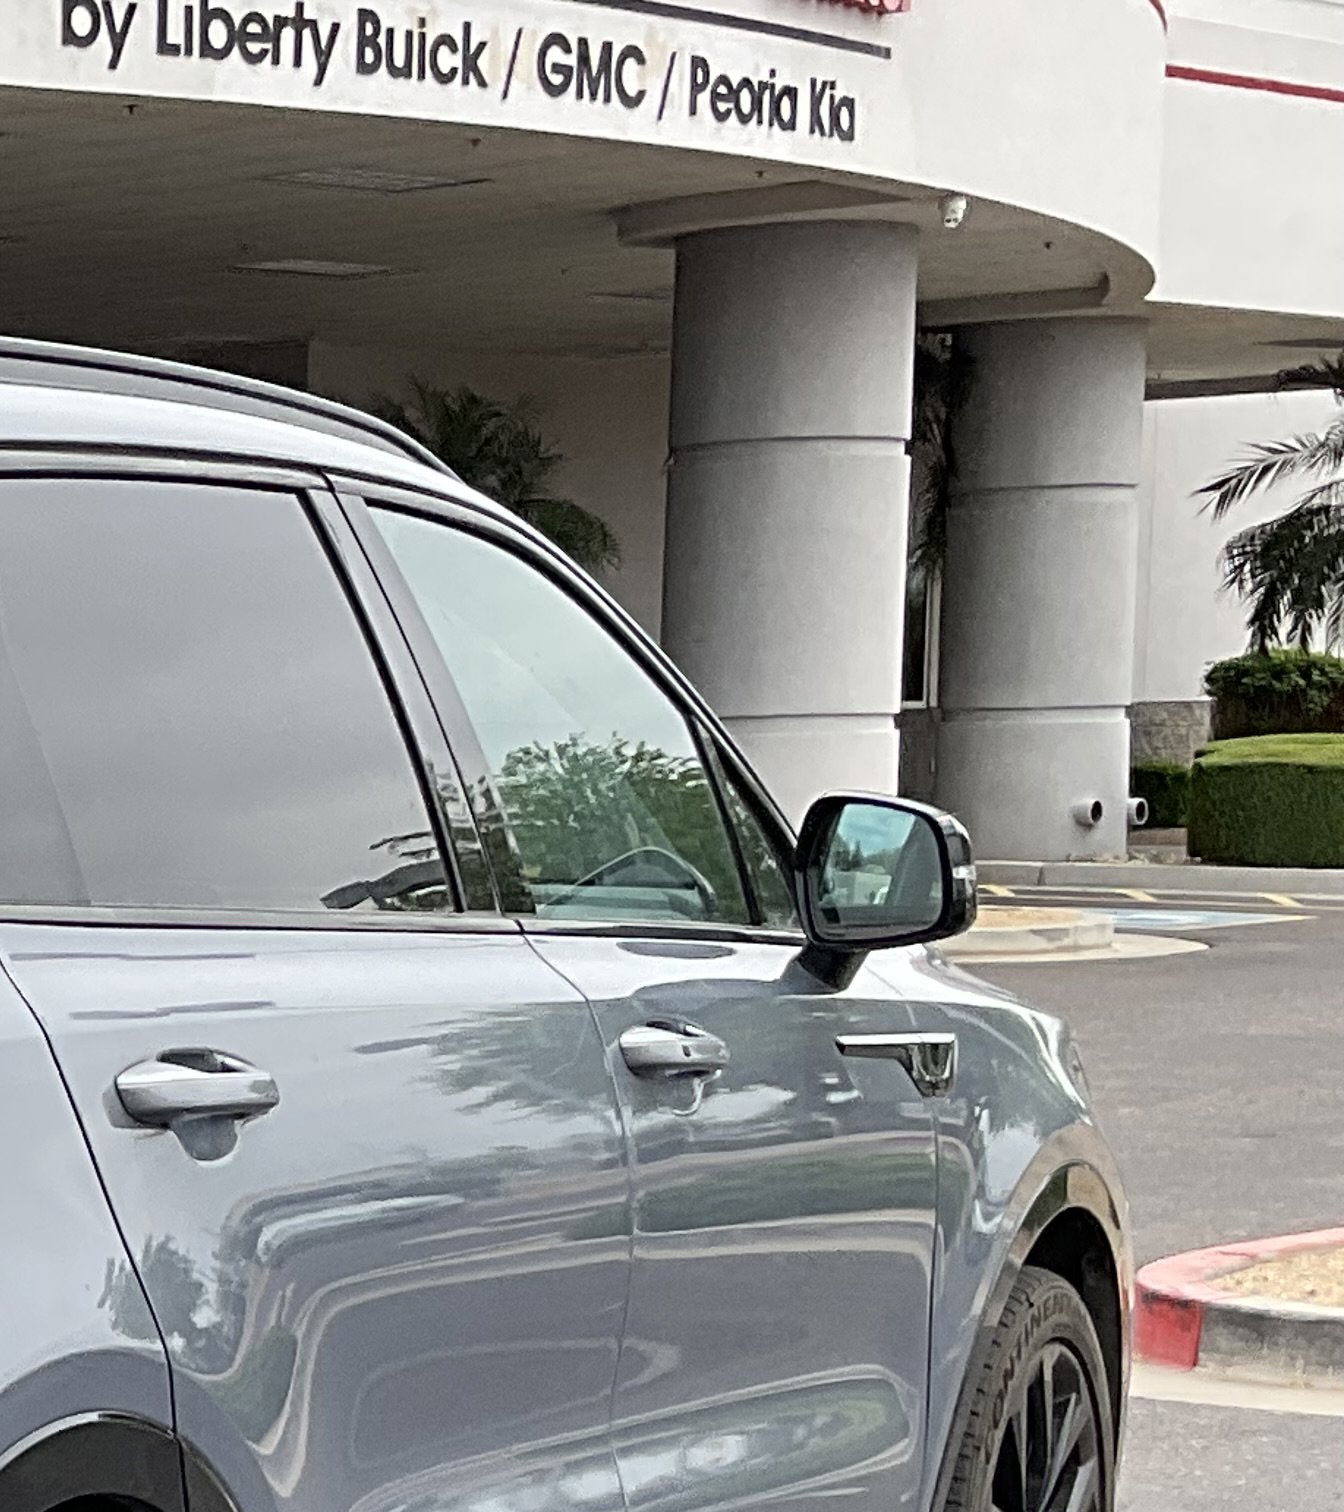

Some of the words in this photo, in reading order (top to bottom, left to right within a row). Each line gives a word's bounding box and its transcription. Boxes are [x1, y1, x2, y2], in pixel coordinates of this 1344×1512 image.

[61, 0, 138, 70] by
[156, 0, 341, 87] Liberty
[356, 8, 488, 88] Buick
[537, 32, 647, 109] GMC
[689, 55, 798, 132] Peoria
[809, 77, 855, 142] Kia
